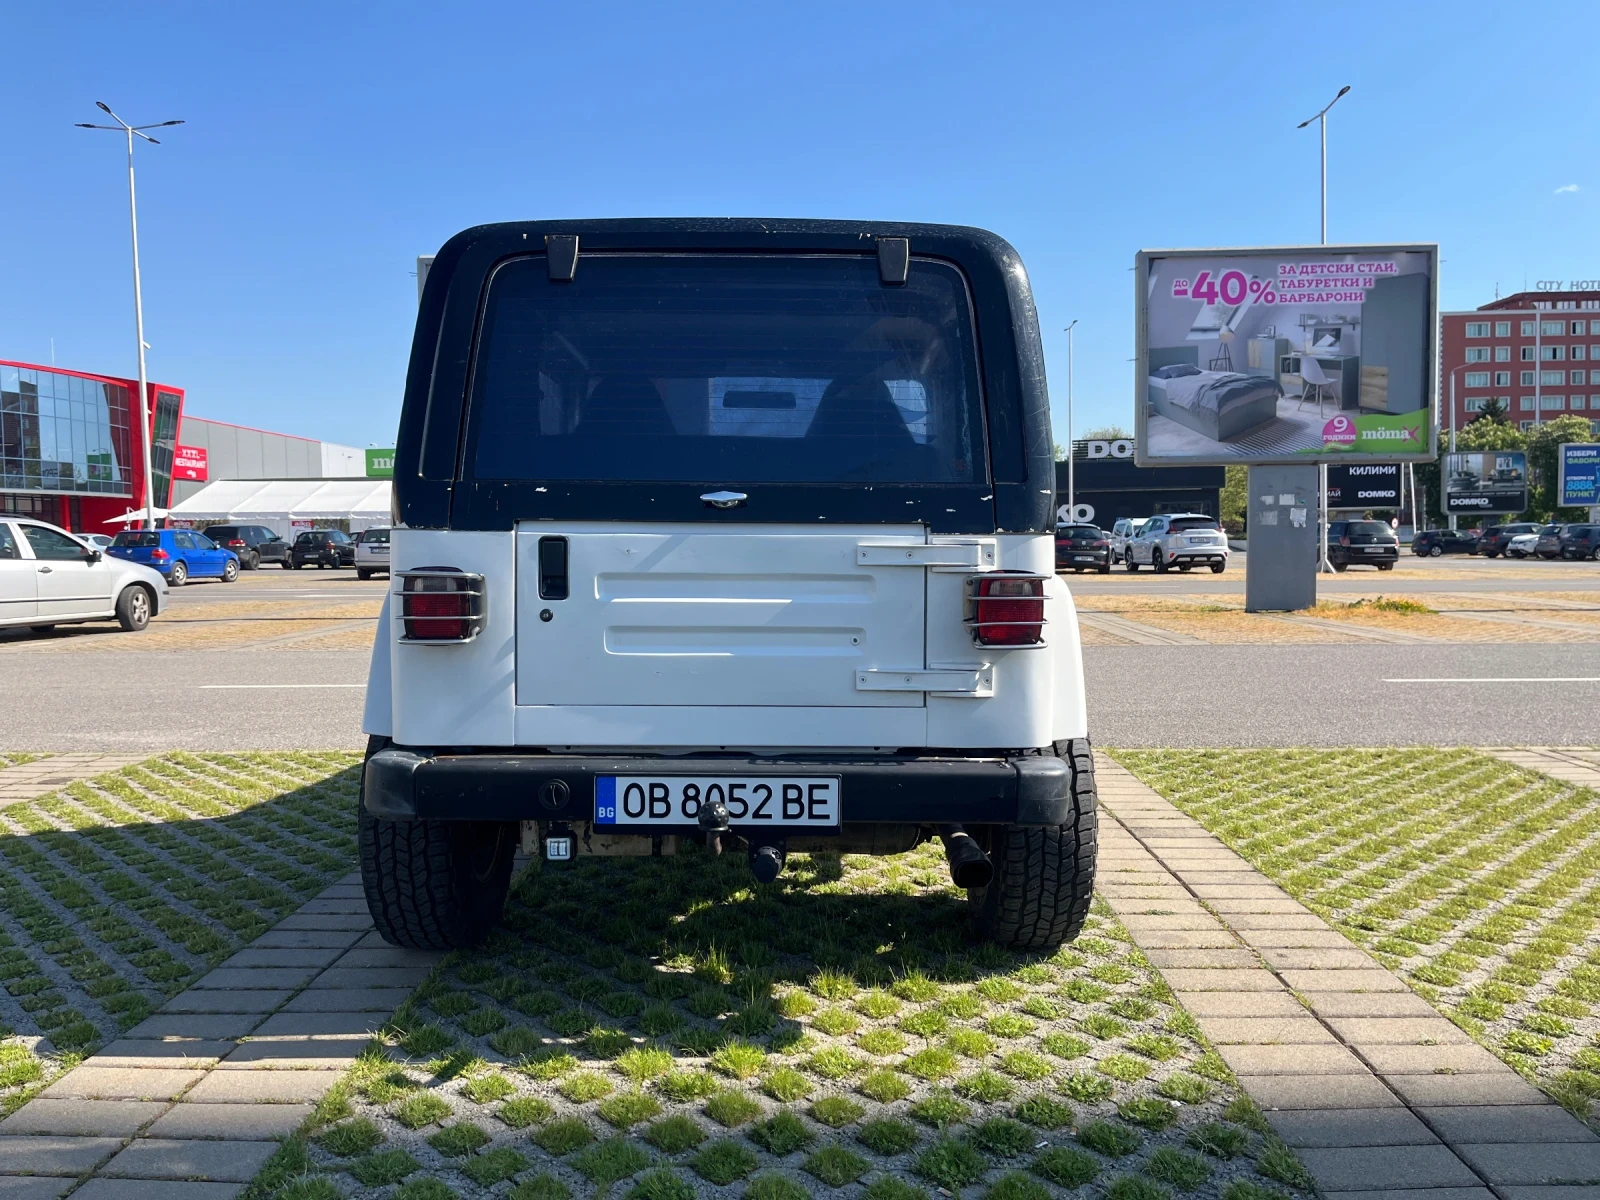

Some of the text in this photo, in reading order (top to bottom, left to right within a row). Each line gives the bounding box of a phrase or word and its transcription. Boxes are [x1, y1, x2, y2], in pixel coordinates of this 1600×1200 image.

[1279, 263, 1397, 276] ЗА ДЕТСКИ СТАИ,
[1279, 277, 1373, 289] ТАБУРЕТКИ И
[1536, 280, 1563, 291] CITY
[1279, 292, 1364, 303] БАРБАРОНИ
[1333, 416, 1348, 432] 9
[175, 457, 206, 469] RESTAURANT
[1567, 457, 1600, 465] ФАВОРИ
[1349, 466, 1396, 476] КИЛИМИ
[1358, 490, 1396, 498] DOMKO
[623, 782, 672, 819] OB
[782, 783, 831, 820] BE
[598, 807, 615, 818] BG
